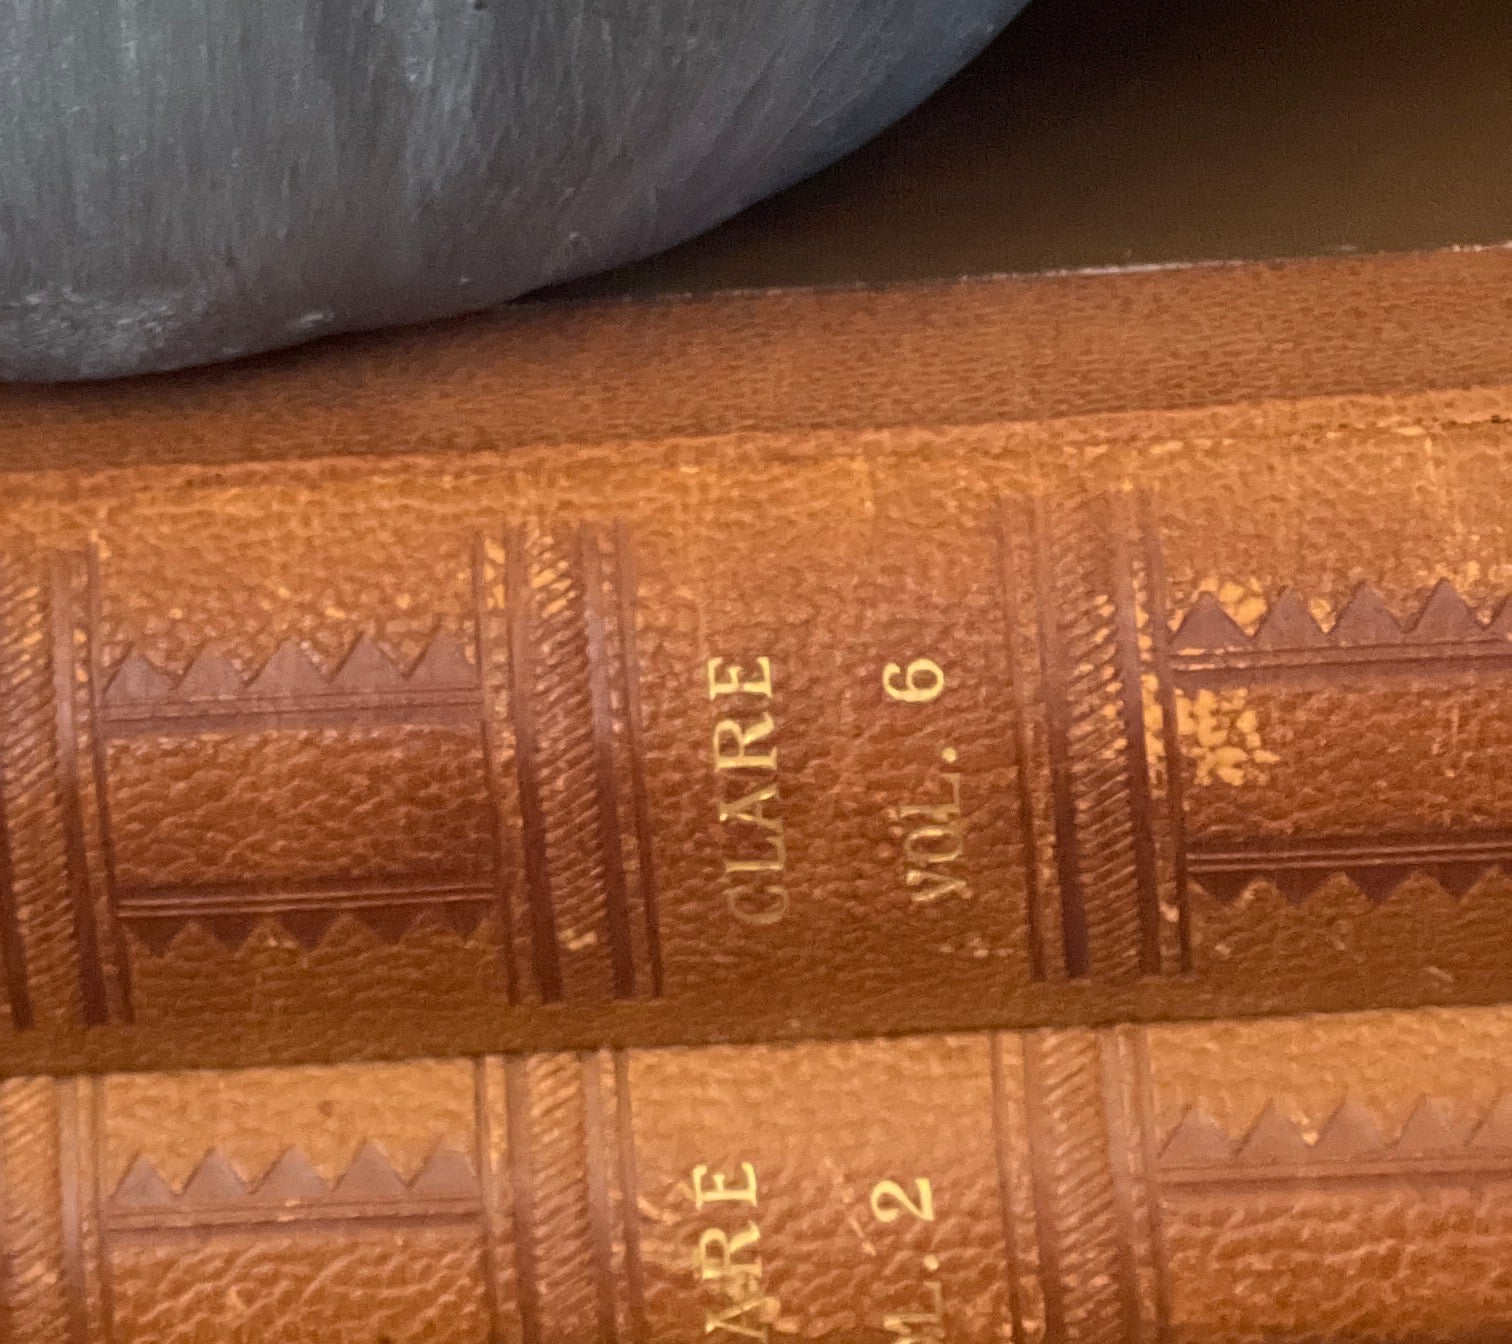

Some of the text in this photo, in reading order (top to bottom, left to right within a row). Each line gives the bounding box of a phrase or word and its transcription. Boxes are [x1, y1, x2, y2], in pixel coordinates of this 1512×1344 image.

[707, 654, 789, 926] CLARE
[881, 657, 972, 910] VOL. 6
[870, 1176, 935, 1223] 2
